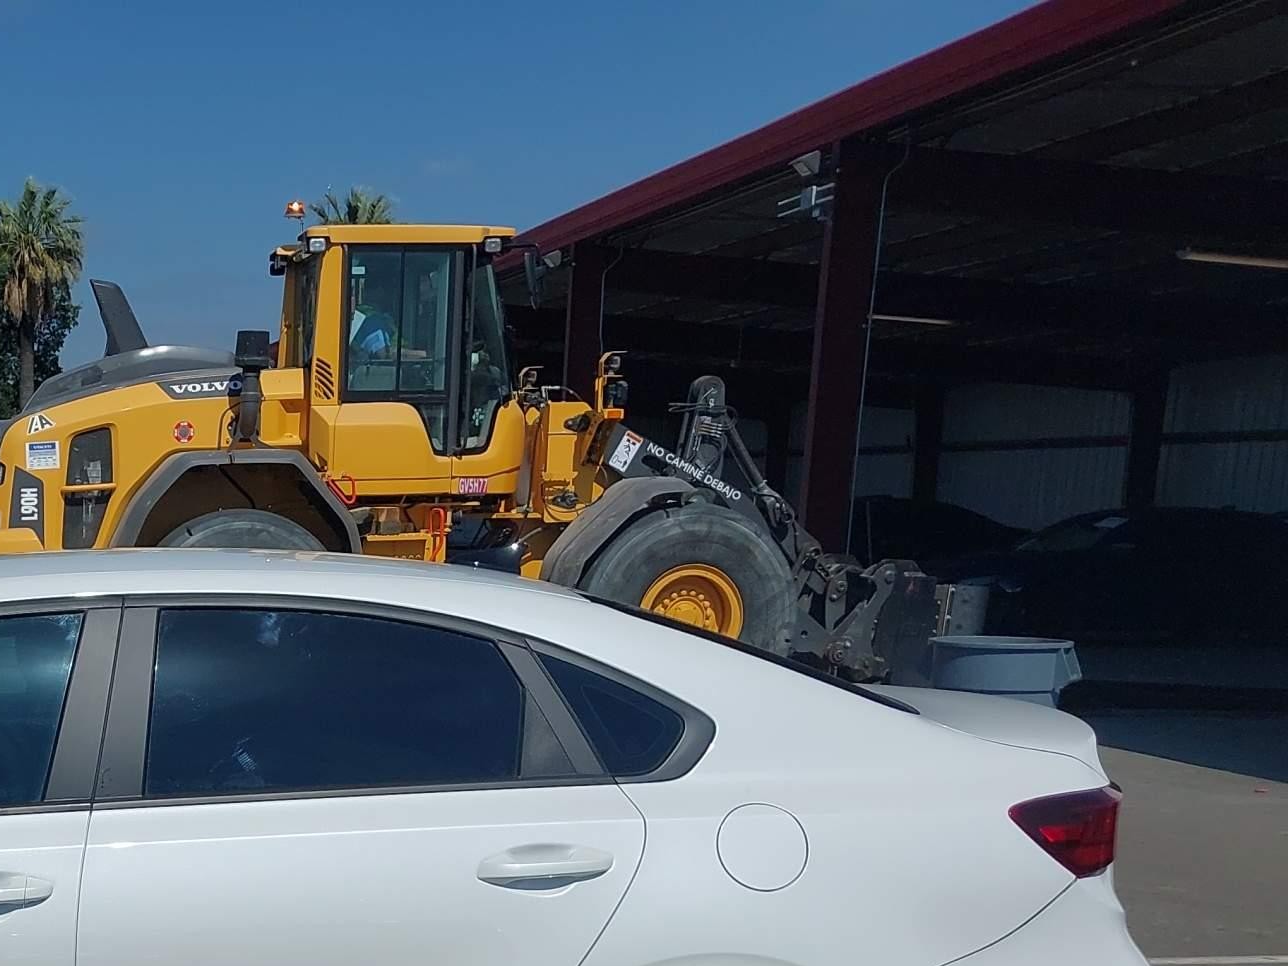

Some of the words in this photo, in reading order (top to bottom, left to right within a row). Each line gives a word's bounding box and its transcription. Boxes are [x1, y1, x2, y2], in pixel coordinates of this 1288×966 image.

[169, 381, 242, 394] VOLVO
[646, 442, 665, 457] NO
[703, 474, 742, 500] DEBAJO
[20, 488, 38, 521] L90H
